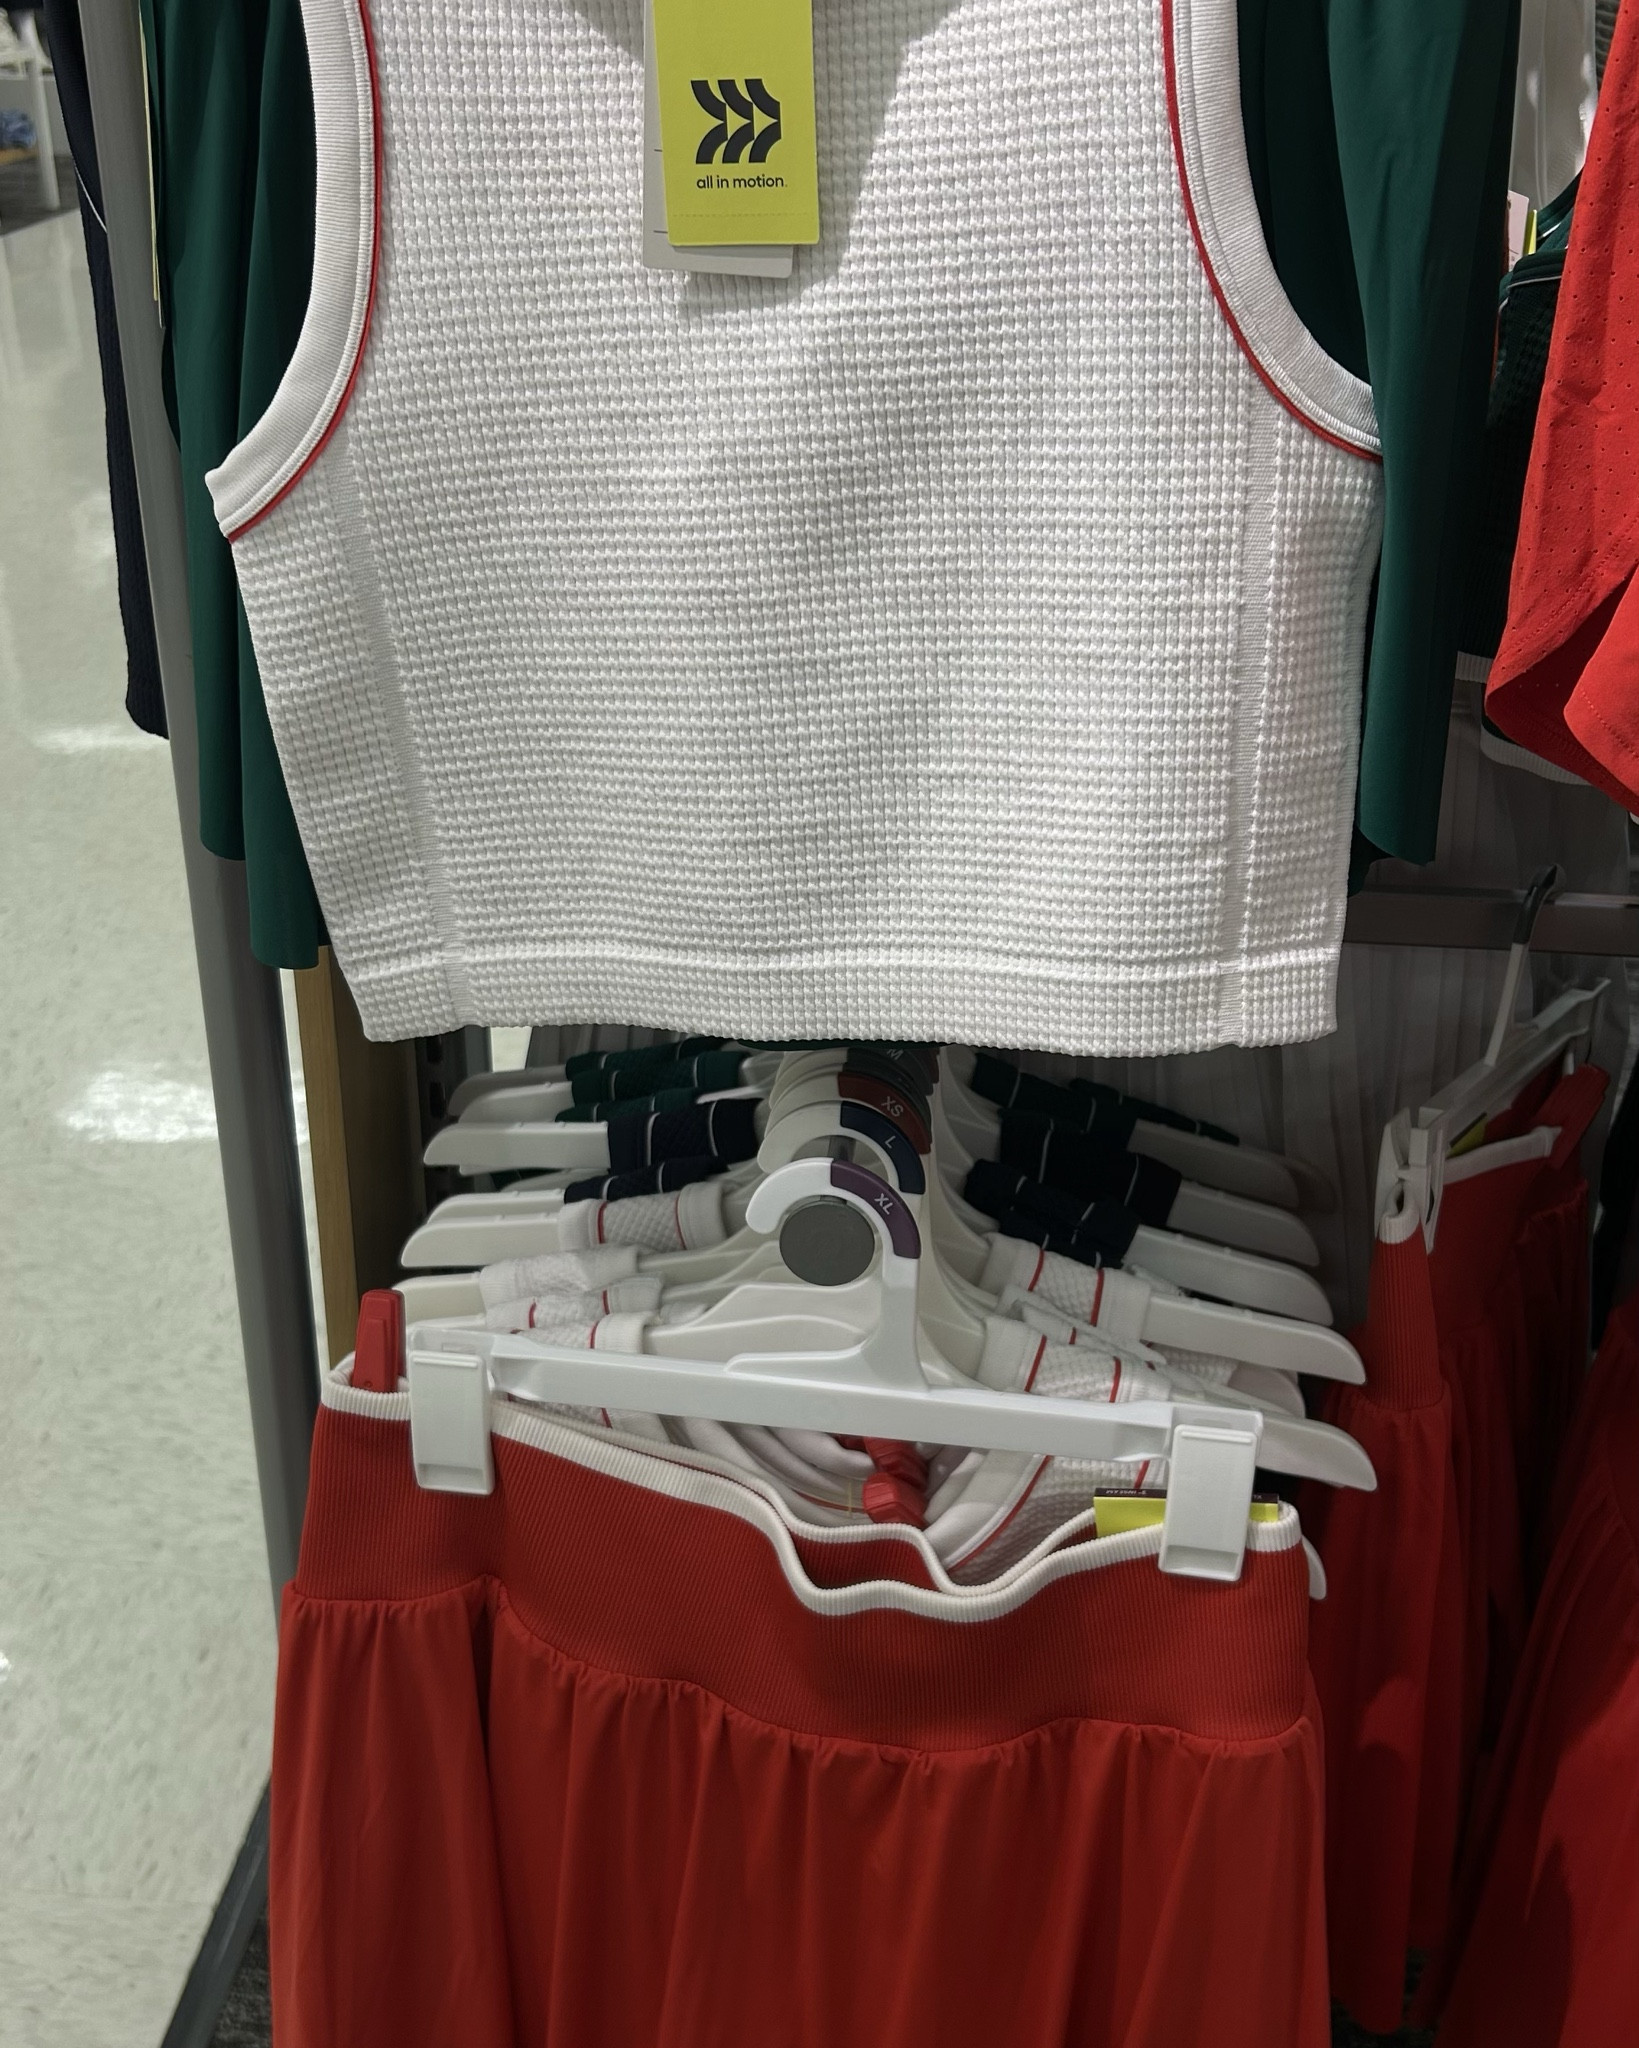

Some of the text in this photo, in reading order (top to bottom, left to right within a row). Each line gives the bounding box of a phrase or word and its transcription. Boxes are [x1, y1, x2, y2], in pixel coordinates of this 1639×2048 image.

[696, 174, 713, 189] all
[716, 174, 729, 189] in
[886, 1049, 904, 1060] M
[881, 1096, 904, 1117] XS
[885, 1135, 896, 1149] L
[874, 1192, 893, 1215] XL
